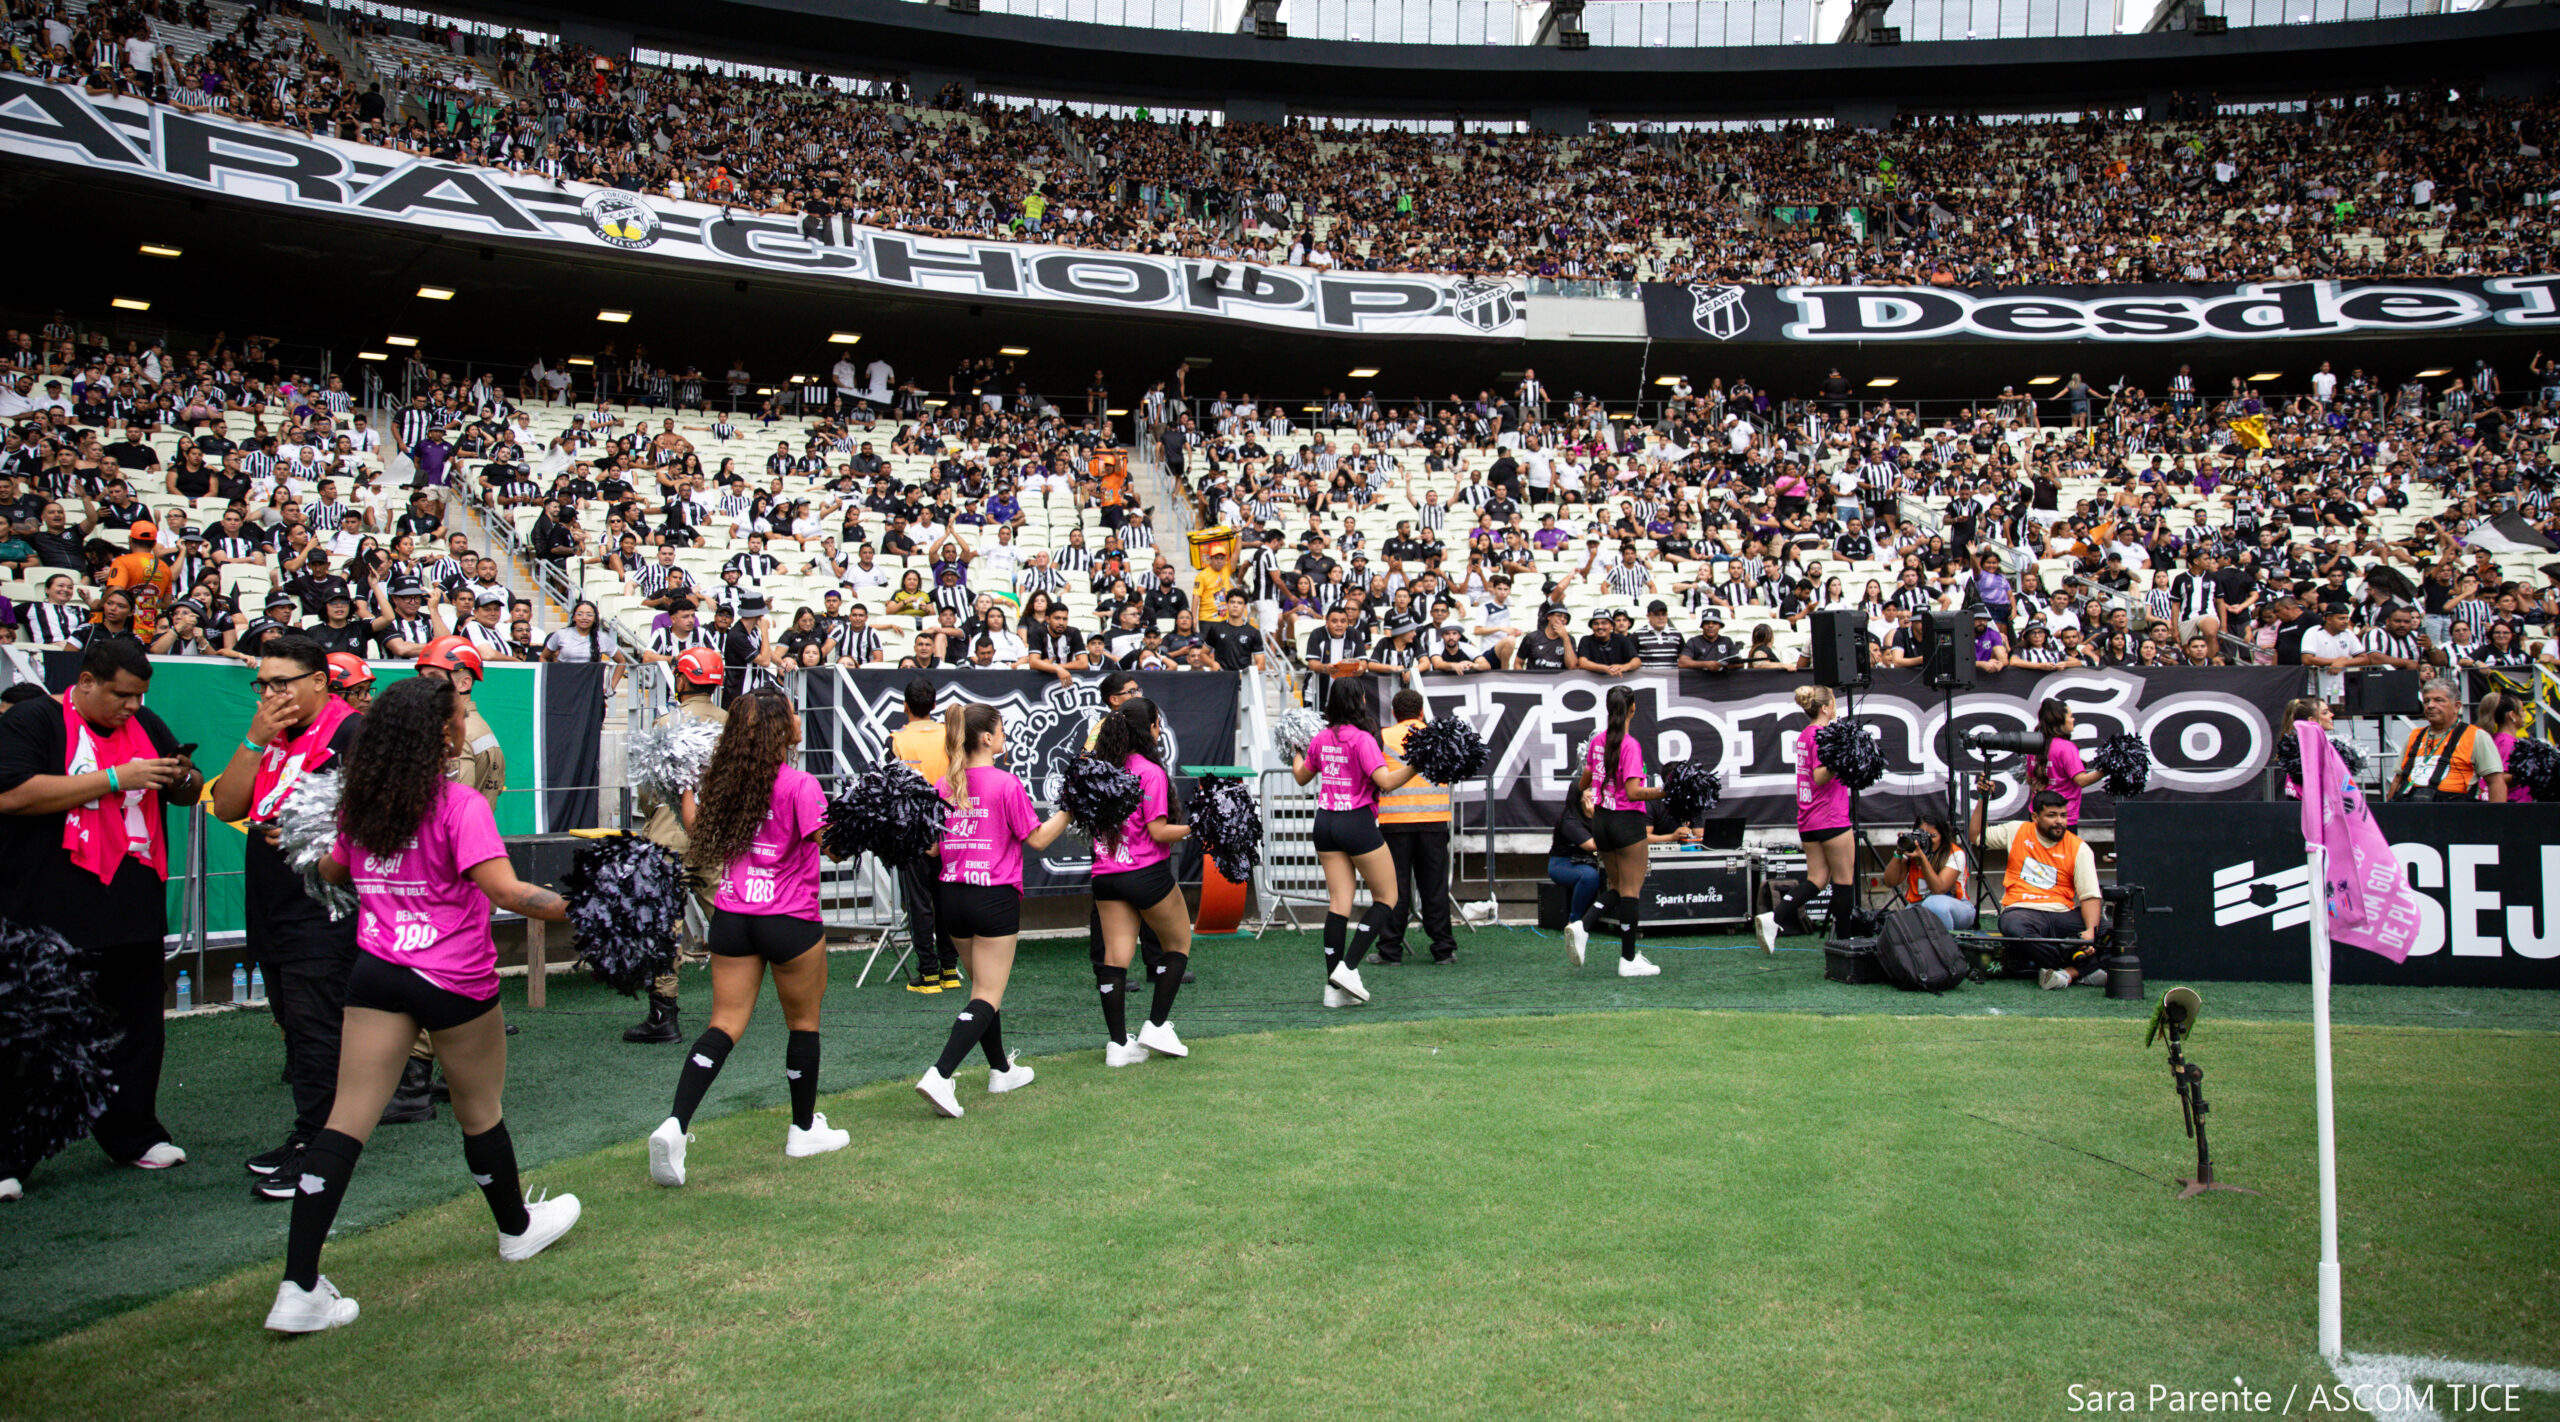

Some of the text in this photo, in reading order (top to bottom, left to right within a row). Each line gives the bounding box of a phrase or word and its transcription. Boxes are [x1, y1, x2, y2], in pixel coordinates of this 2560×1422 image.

[547, 97, 559, 108] 10
[702, 207, 1446, 334] CHOPP
[744, 878, 776, 904] 180
[2366, 862, 2397, 893] GOL
[1655, 894, 1684, 907] Spark
[393, 923, 438, 952] 180
[2377, 921, 2410, 950] DE
